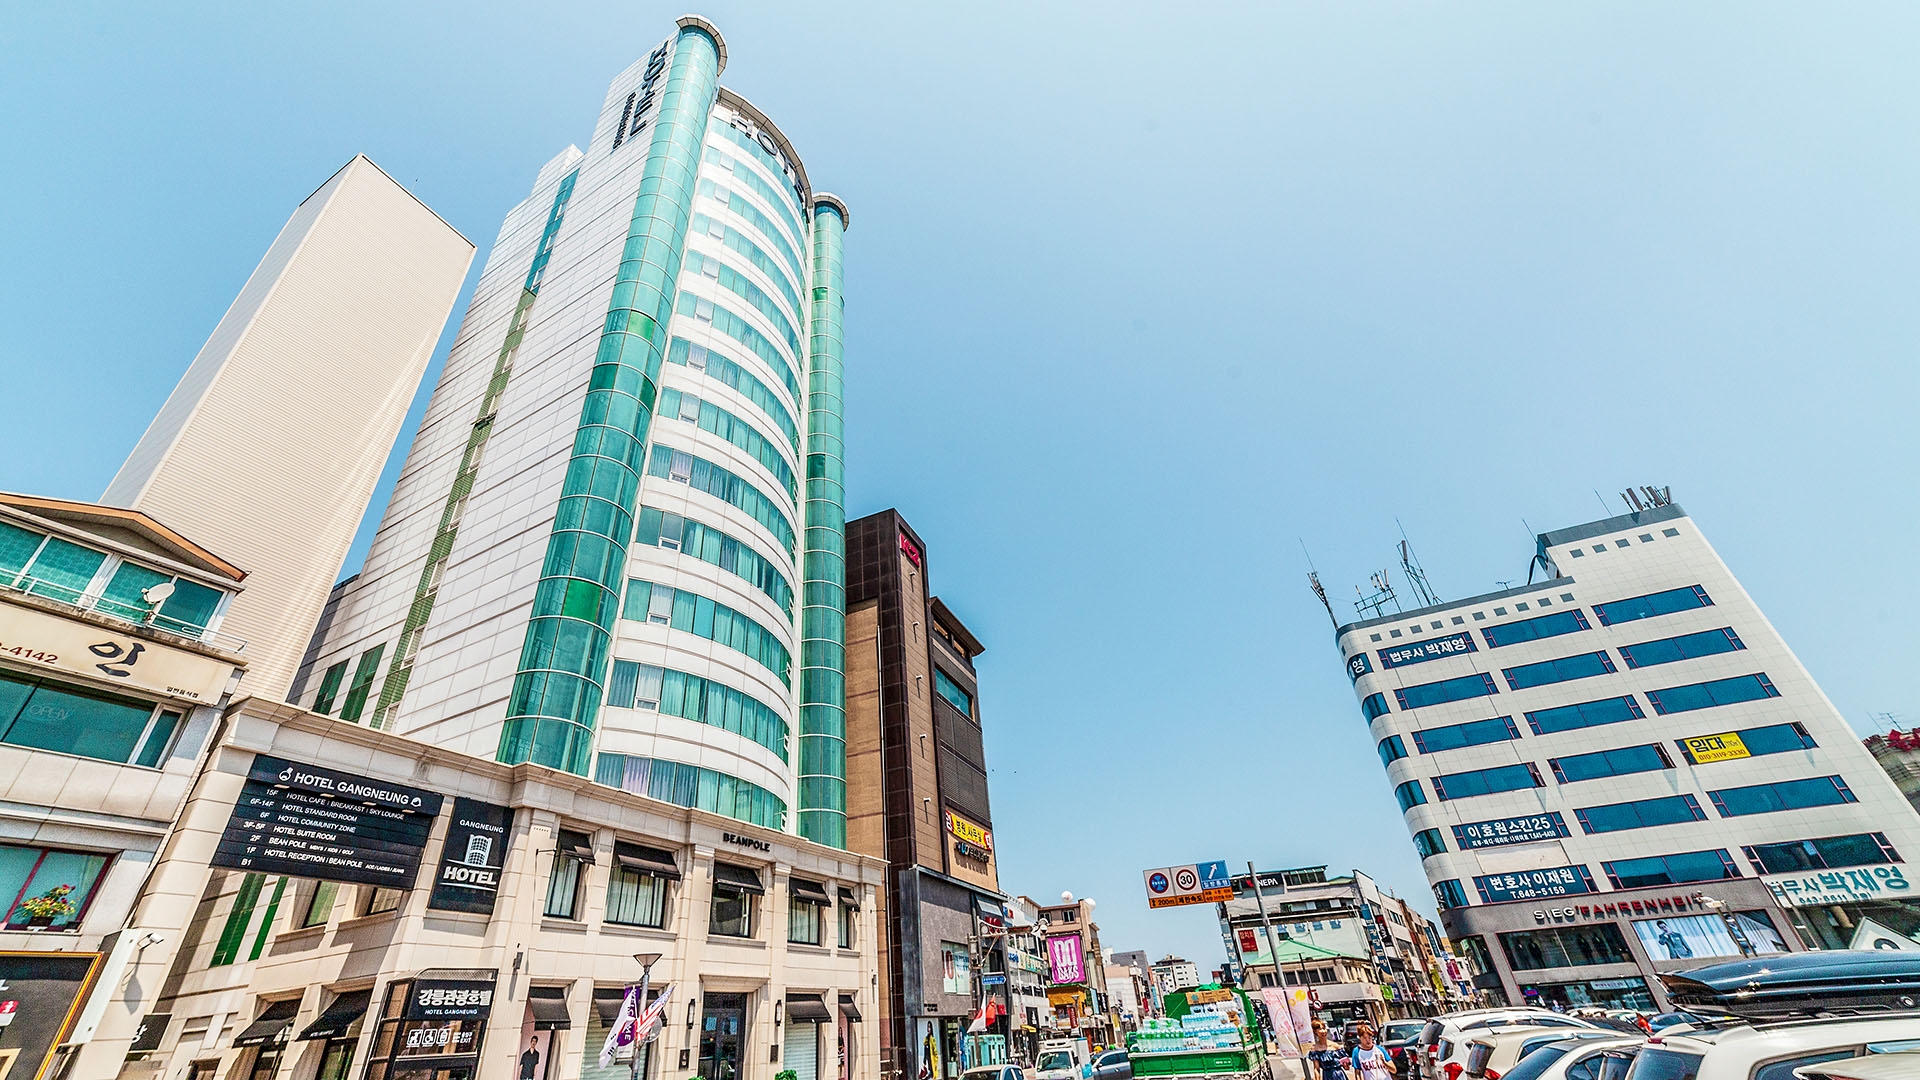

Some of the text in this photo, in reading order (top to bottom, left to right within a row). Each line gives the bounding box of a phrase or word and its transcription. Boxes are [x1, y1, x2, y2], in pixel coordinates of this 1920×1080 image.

[730, 109, 805, 204] HOTE
[0, 642, 58, 664] -4142
[1389, 637, 1467, 663] 법무사 박재영
[1689, 736, 1726, 753] 임대
[294, 773, 410, 805] HOTEL GANGNEUNG
[250, 798, 358, 822] 6F-14F HOTEL STANDARD ROOM
[286, 792, 308, 803] HOTEL
[330, 801, 365, 813] BREAKFAST
[277, 815, 300, 825] HOTEL
[300, 818, 339, 830] COMMUNITY
[338, 825, 357, 833] ZONE
[460, 820, 504, 833] GANGNEUNG
[1467, 816, 1551, 838] 이효원스킨25
[269, 837, 288, 847] BEAN
[287, 840, 307, 849] POLE
[273, 826, 296, 836] HOTEL
[296, 830, 316, 839] SUITE
[316, 833, 337, 842] ROOM
[723, 832, 770, 852] BEANPOLE
[241, 858, 251, 866] B1
[264, 849, 286, 860] HOTEL
[286, 852, 326, 864] RECEPTION
[328, 858, 347, 866] BEAN
[347, 860, 363, 868] POLE
[443, 866, 497, 886] HOTEL
[1180, 874, 1192, 885] 30
[1259, 878, 1278, 887] NEPA
[1489, 868, 1576, 891] 변호사 이재원
[1818, 866, 1909, 895] 박재영
[1510, 886, 1565, 899] T.648-5159
[1533, 907, 1575, 920] SIEG
[418, 989, 493, 1006] 강릉관광호텔
